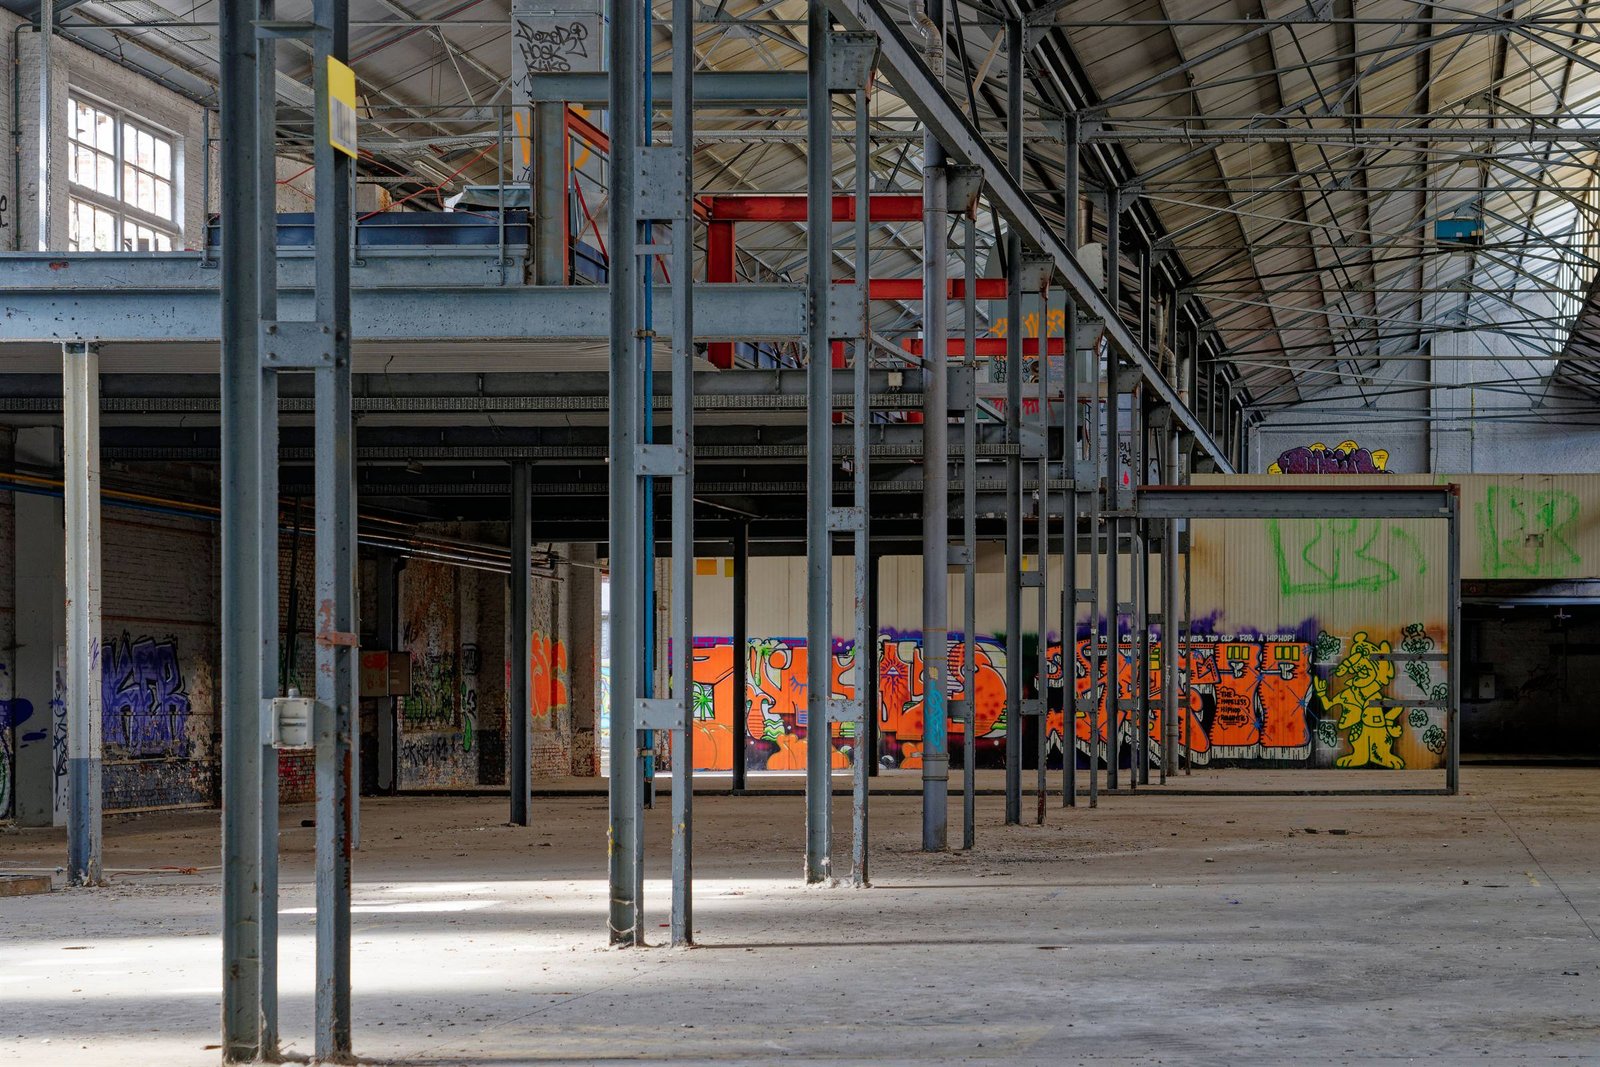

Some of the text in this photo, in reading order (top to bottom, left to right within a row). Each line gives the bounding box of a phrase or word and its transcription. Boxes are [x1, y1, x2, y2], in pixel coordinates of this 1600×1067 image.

[1179, 634, 1204, 643] NVER
[1220, 634, 1234, 643] OLD
[1258, 633, 1265, 642] A
